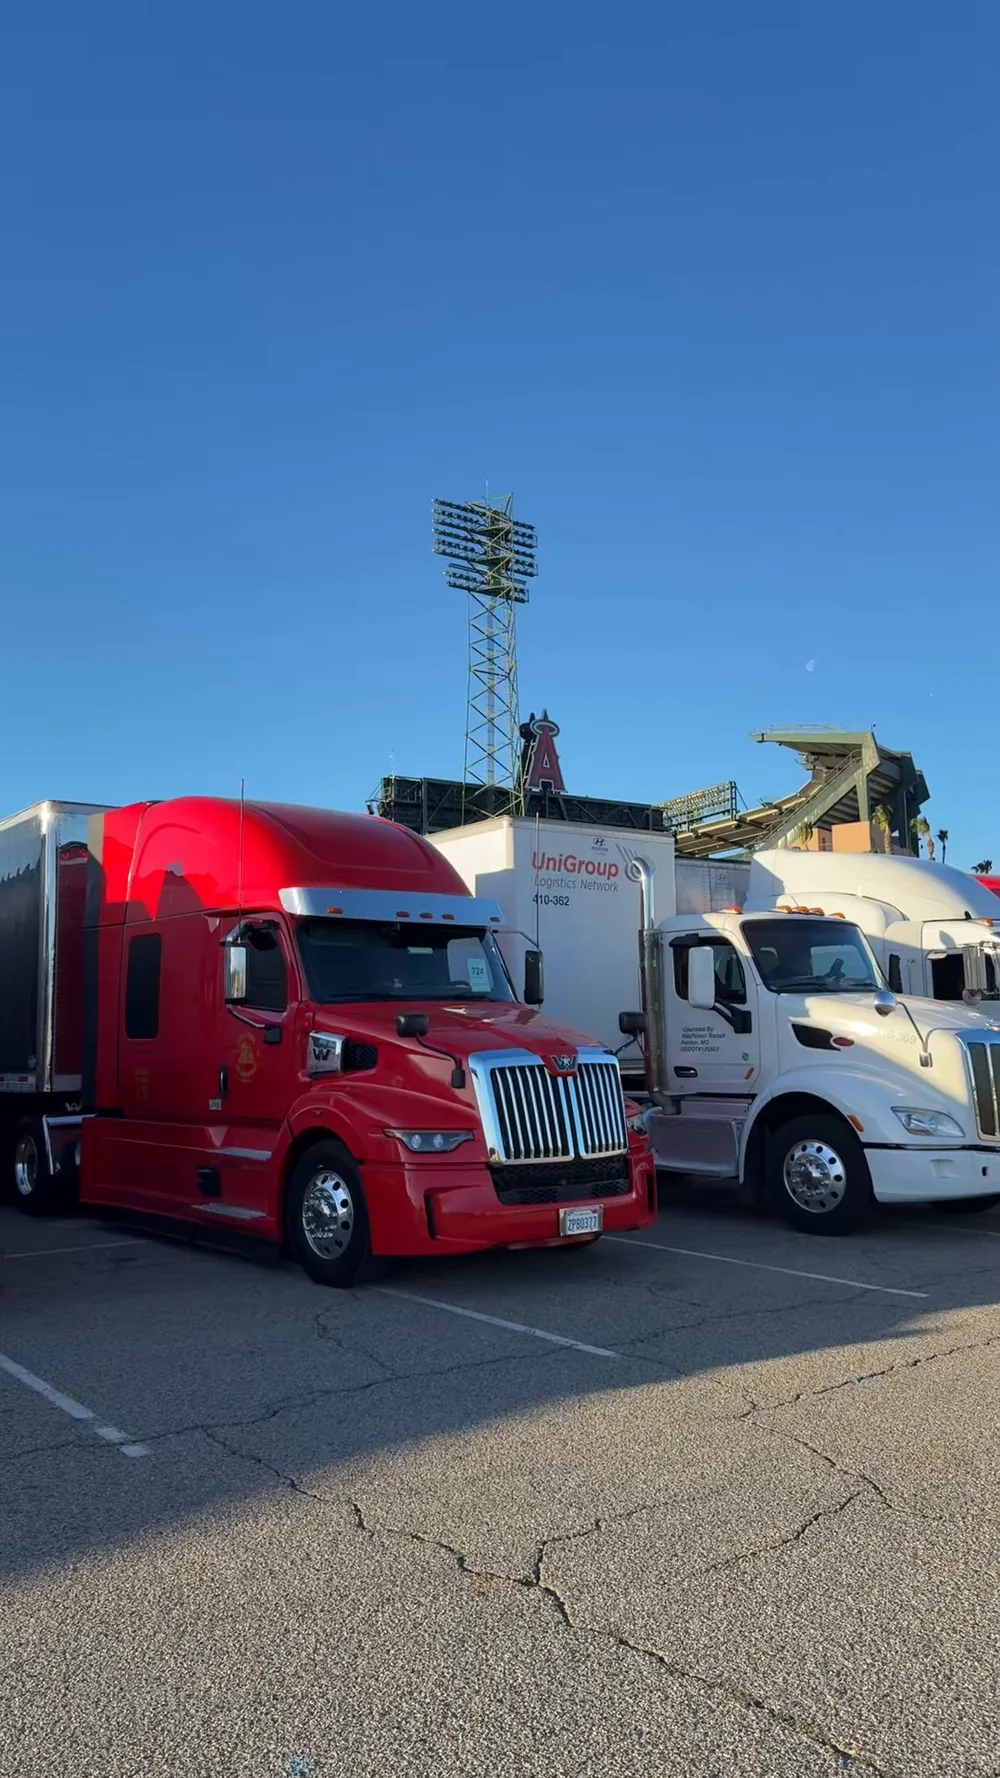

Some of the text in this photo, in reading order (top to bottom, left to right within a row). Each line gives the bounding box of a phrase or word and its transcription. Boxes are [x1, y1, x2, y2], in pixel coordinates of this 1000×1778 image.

[525, 727, 569, 793] A
[531, 851, 619, 880] UniGroup
[534, 876, 619, 892] Logistics Network
[532, 894, 570, 906] 410-362
[471, 966, 484, 976] 724
[567, 1216, 598, 1232] ZP80377
